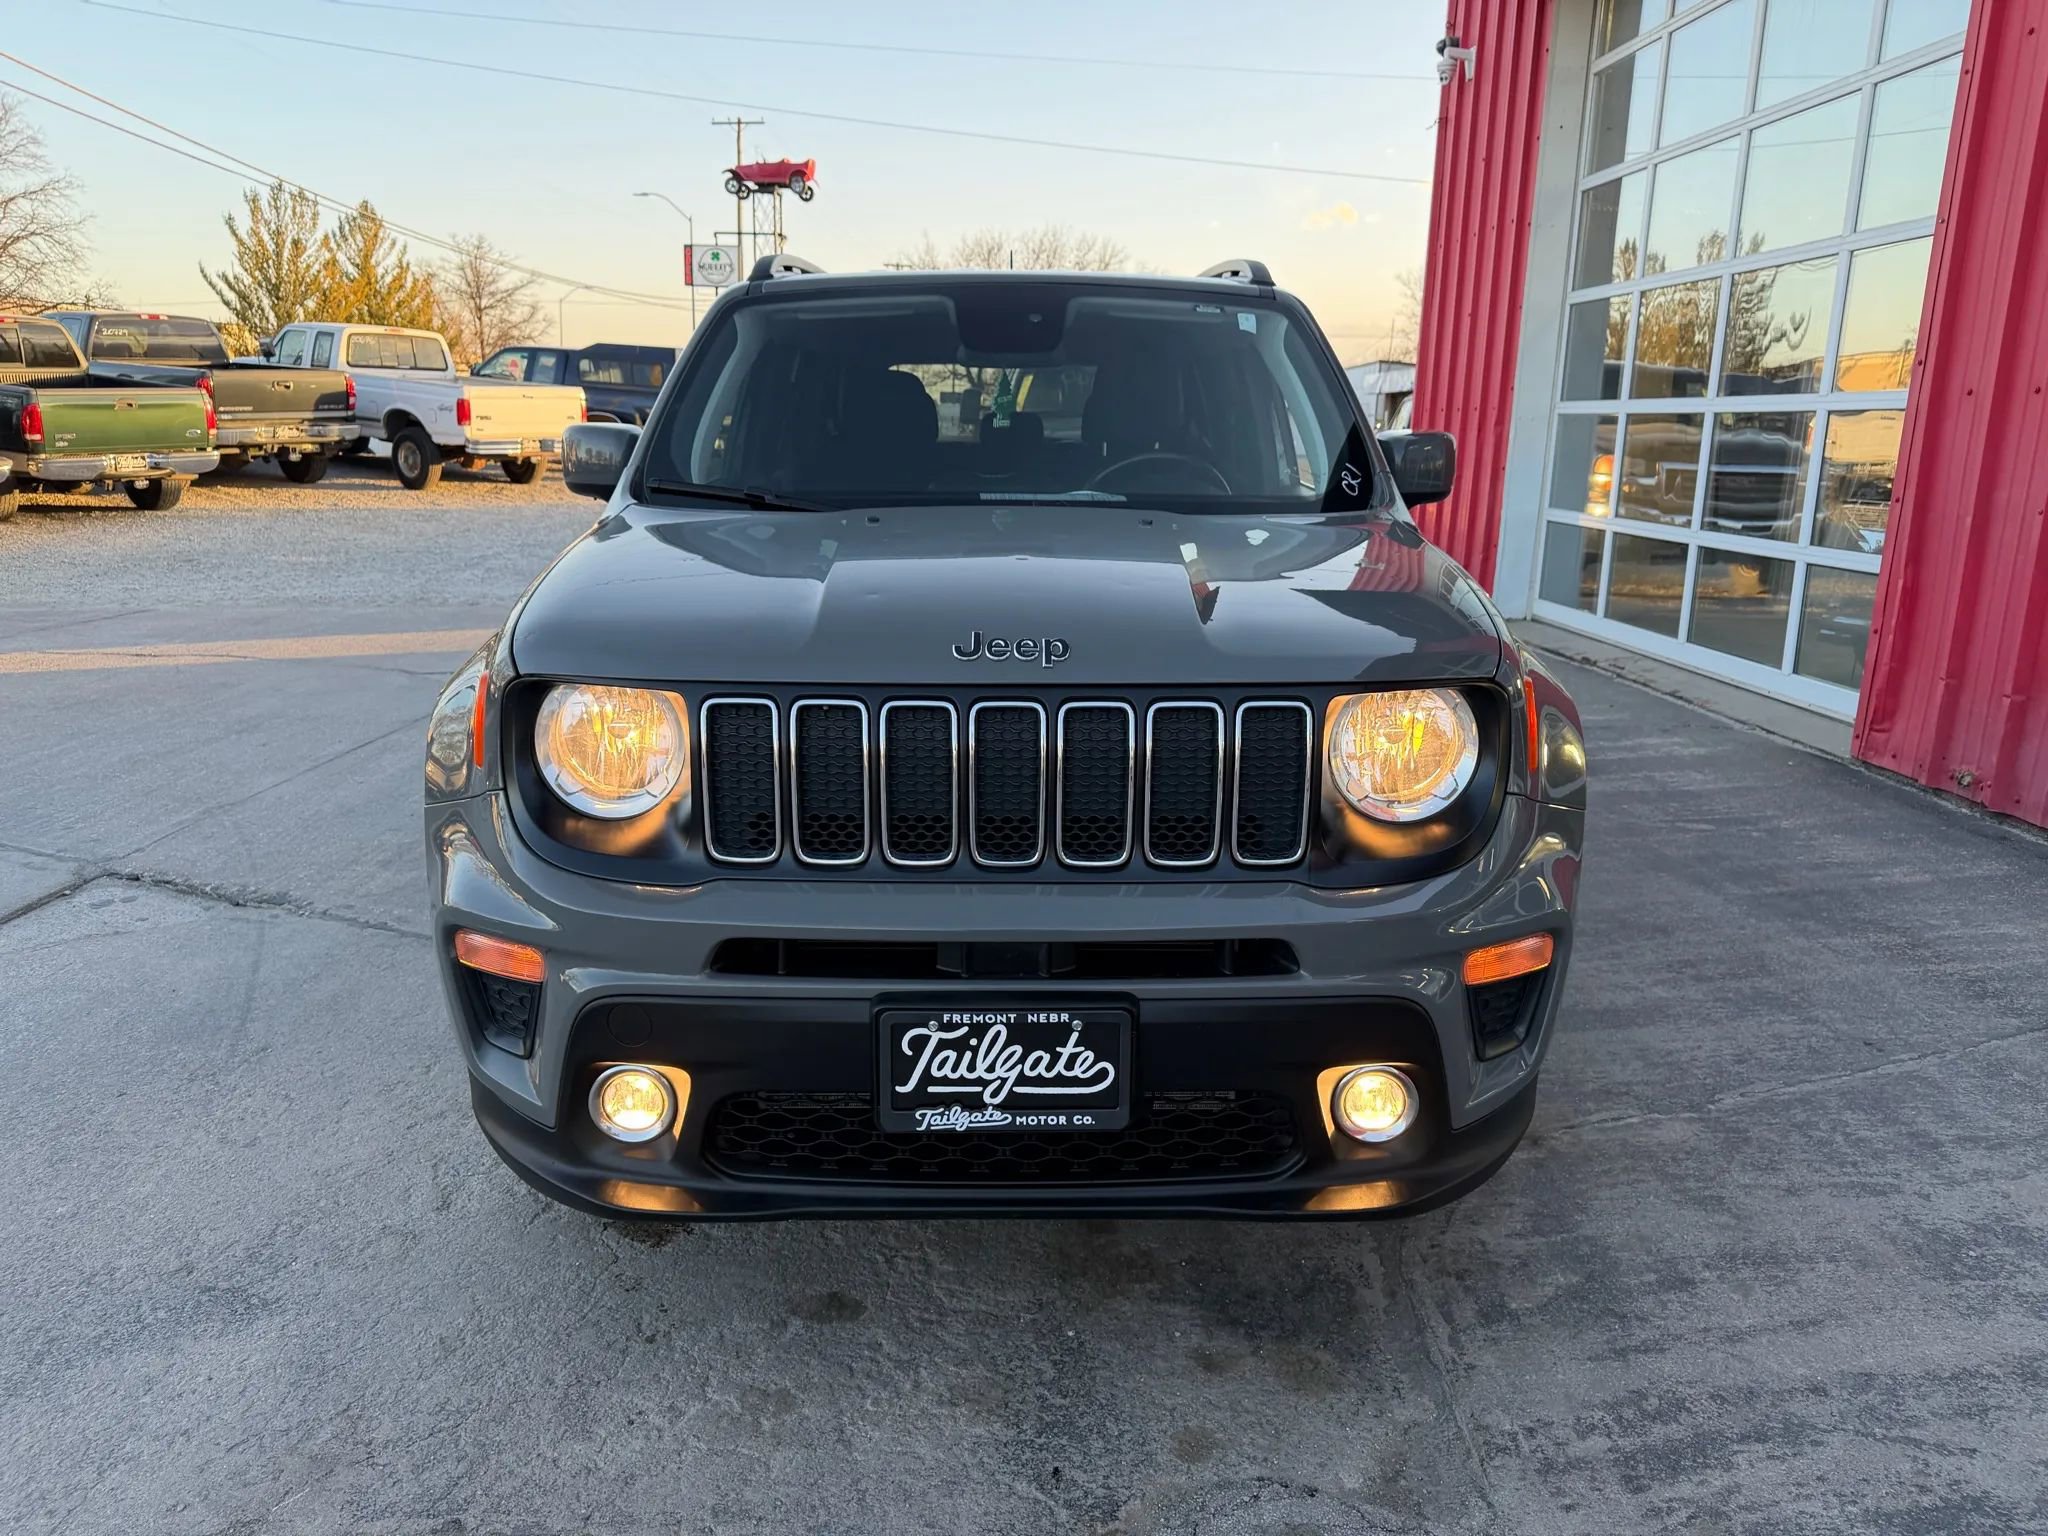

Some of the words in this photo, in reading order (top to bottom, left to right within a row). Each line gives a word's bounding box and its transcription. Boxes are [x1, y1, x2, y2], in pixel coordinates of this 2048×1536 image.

[952, 631, 1070, 668] Jeep
[943, 1013, 1017, 1024] FREMONT
[1027, 1013, 1070, 1023] NEBR
[895, 1023, 1116, 1104] Tailgate
[915, 1105, 1012, 1131] Tailgate
[1015, 1115, 1067, 1126] MOTOR
